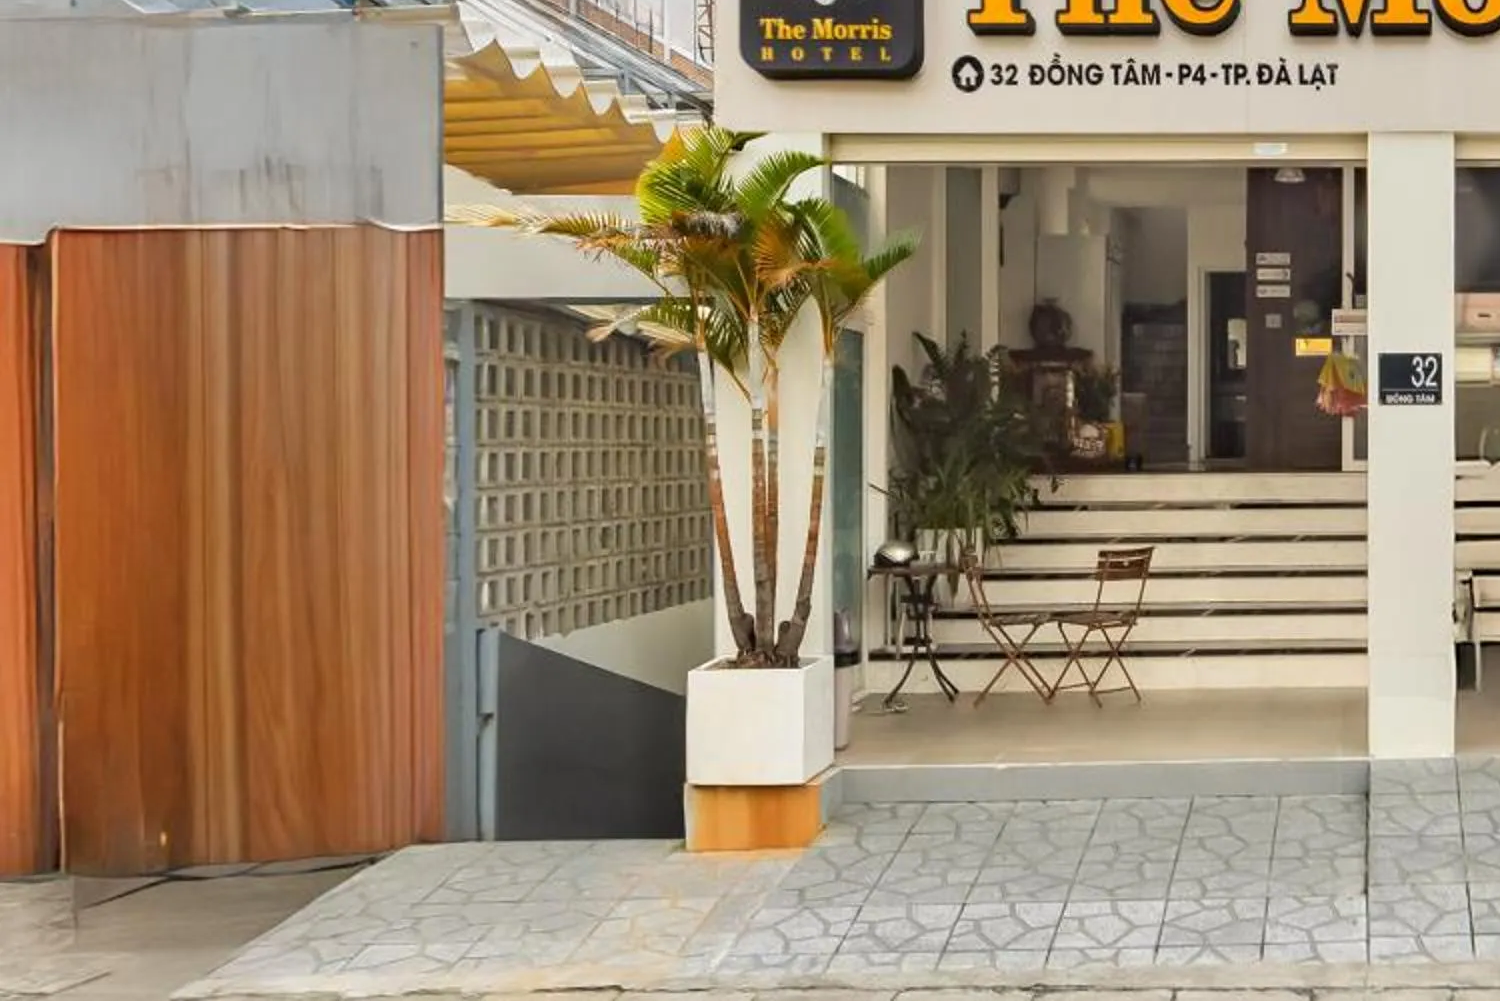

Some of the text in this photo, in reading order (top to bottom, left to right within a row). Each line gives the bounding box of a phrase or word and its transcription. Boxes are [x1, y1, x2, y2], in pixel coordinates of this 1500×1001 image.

[759, 17, 893, 40] The Morris
[760, 46, 892, 62] HOTEL
[990, 63, 1019, 86] 32
[1027, 52, 1104, 86] ĐỒNG
[1256, 57, 1292, 86] ĐÀ
[1299, 63, 1338, 91] LẠT
[1411, 356, 1438, 387] 32
